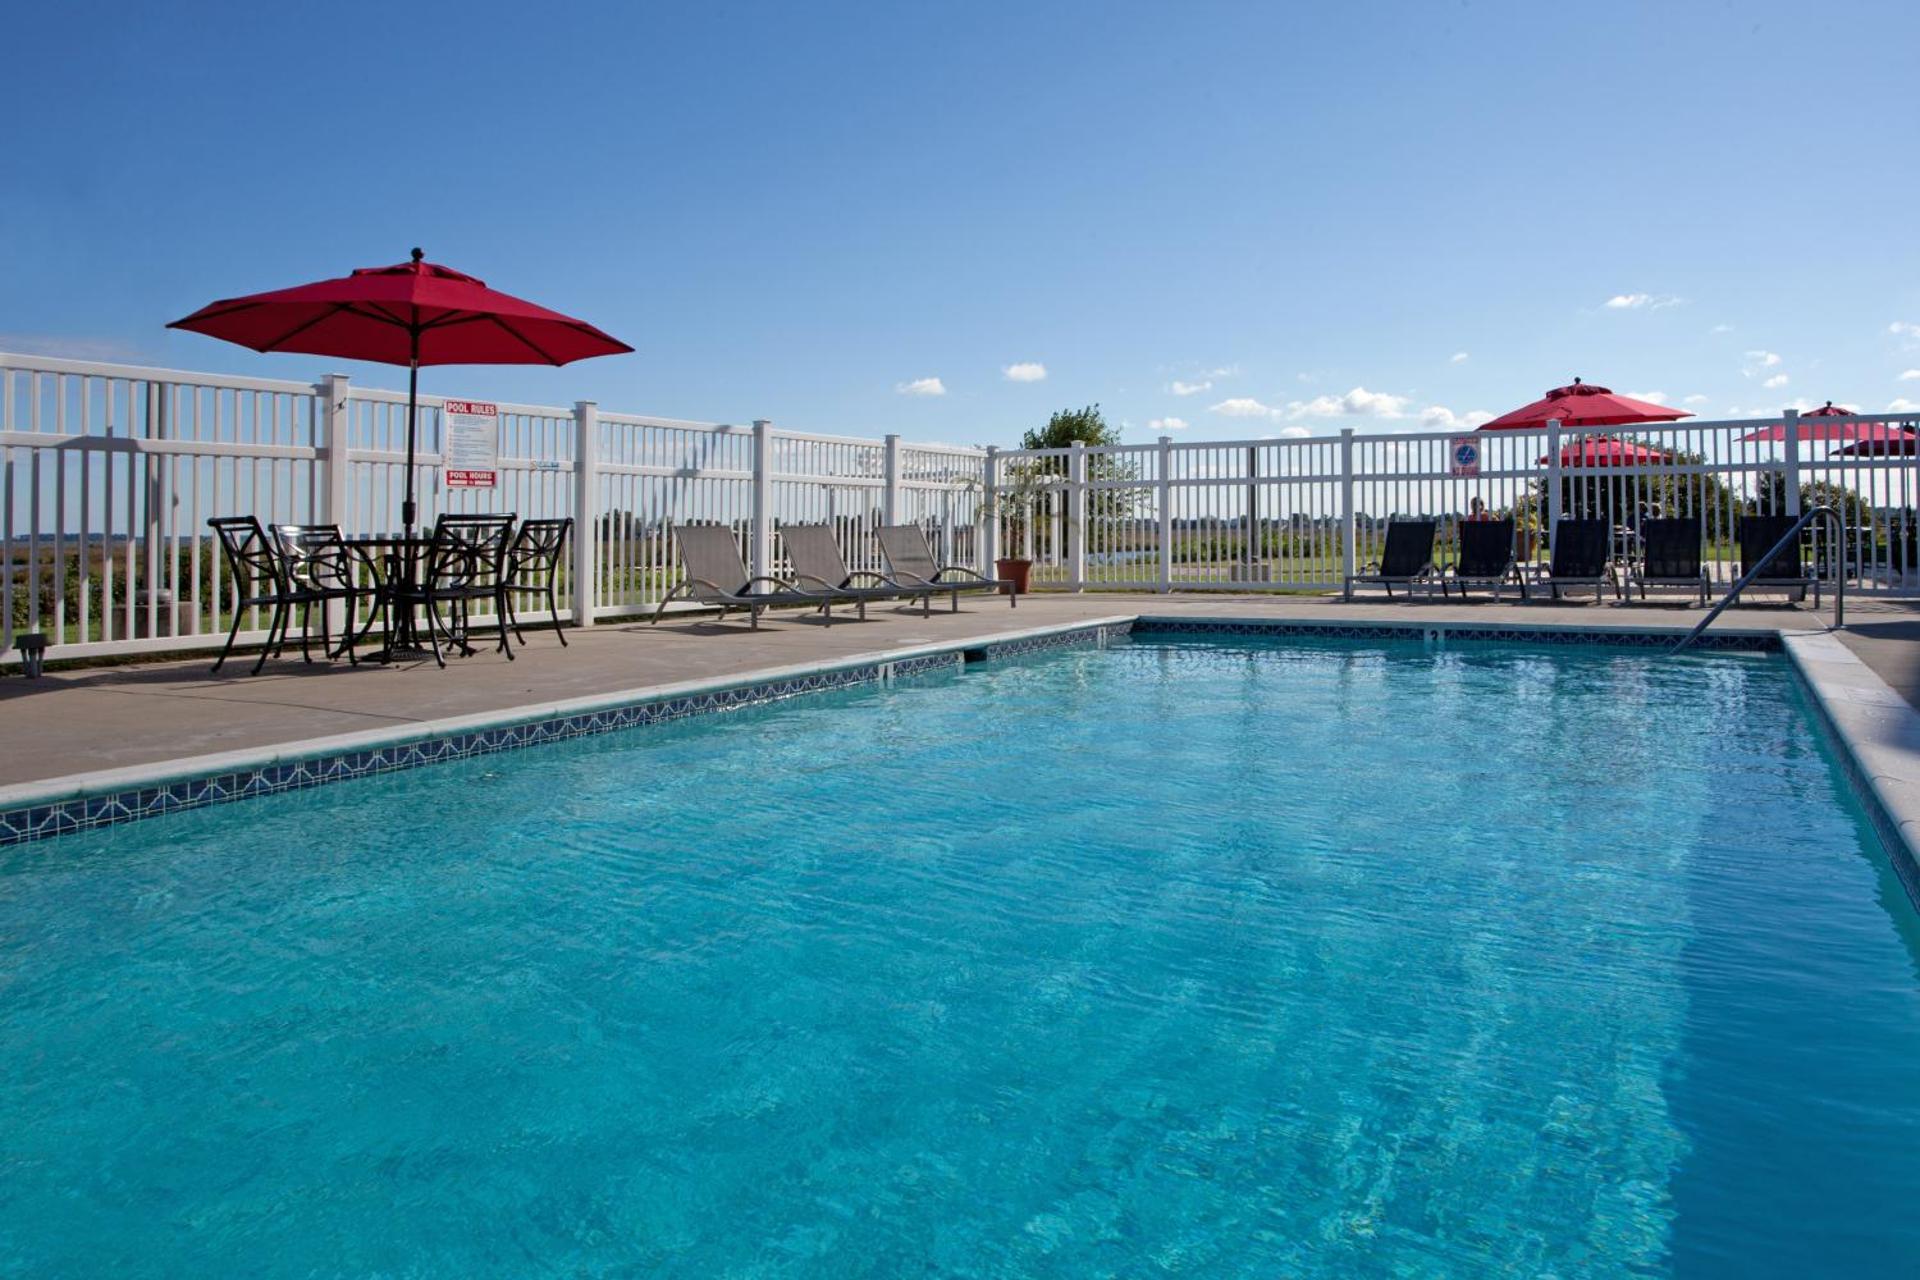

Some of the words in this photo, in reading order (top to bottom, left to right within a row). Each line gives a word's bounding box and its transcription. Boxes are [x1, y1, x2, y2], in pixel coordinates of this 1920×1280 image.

[447, 402, 469, 413] POOL
[471, 404, 495, 415] RULES
[449, 471, 468, 479] POOL
[469, 472, 492, 480] HOURS
